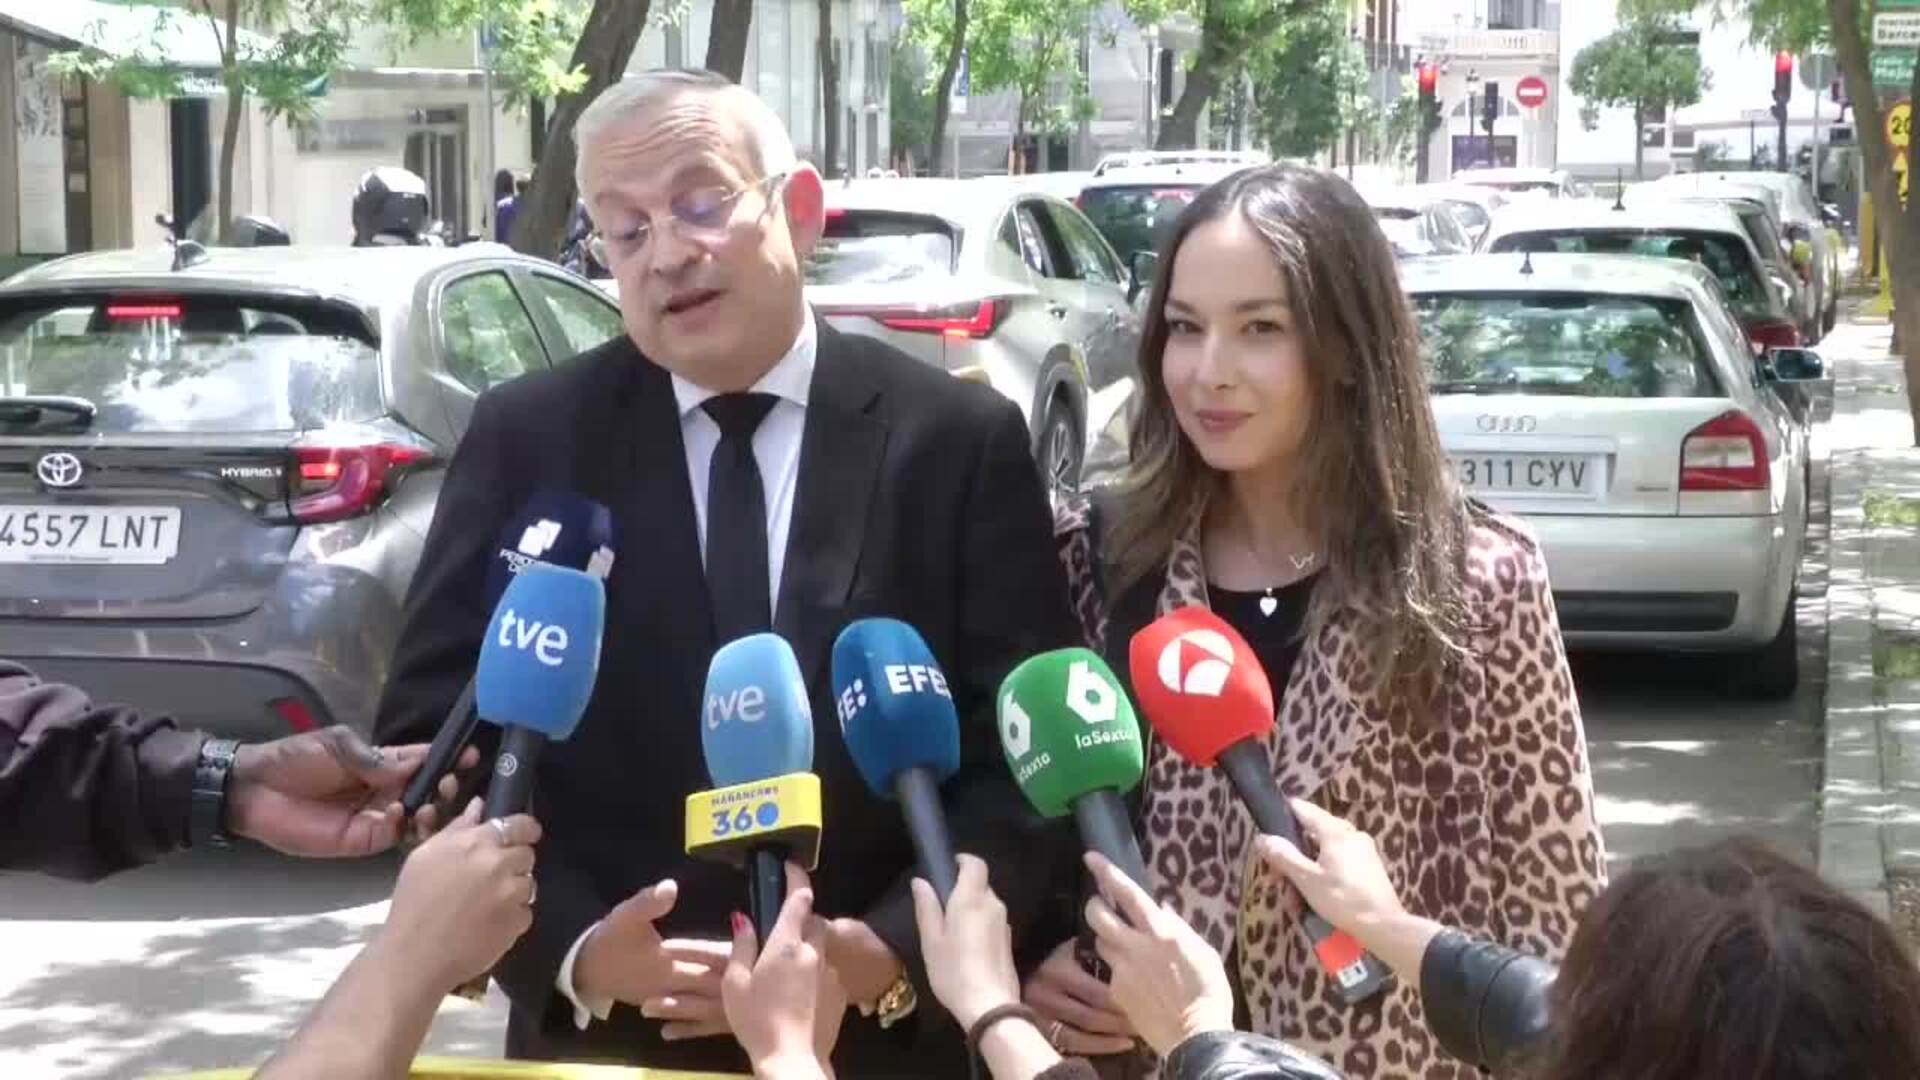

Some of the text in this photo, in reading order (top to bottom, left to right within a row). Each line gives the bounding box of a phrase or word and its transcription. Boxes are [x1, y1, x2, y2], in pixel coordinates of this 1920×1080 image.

[1447, 458, 1585, 487] 311 CYV
[0, 514, 169, 548] 4557 LNT
[499, 608, 568, 666] tve
[706, 685, 766, 731] tve
